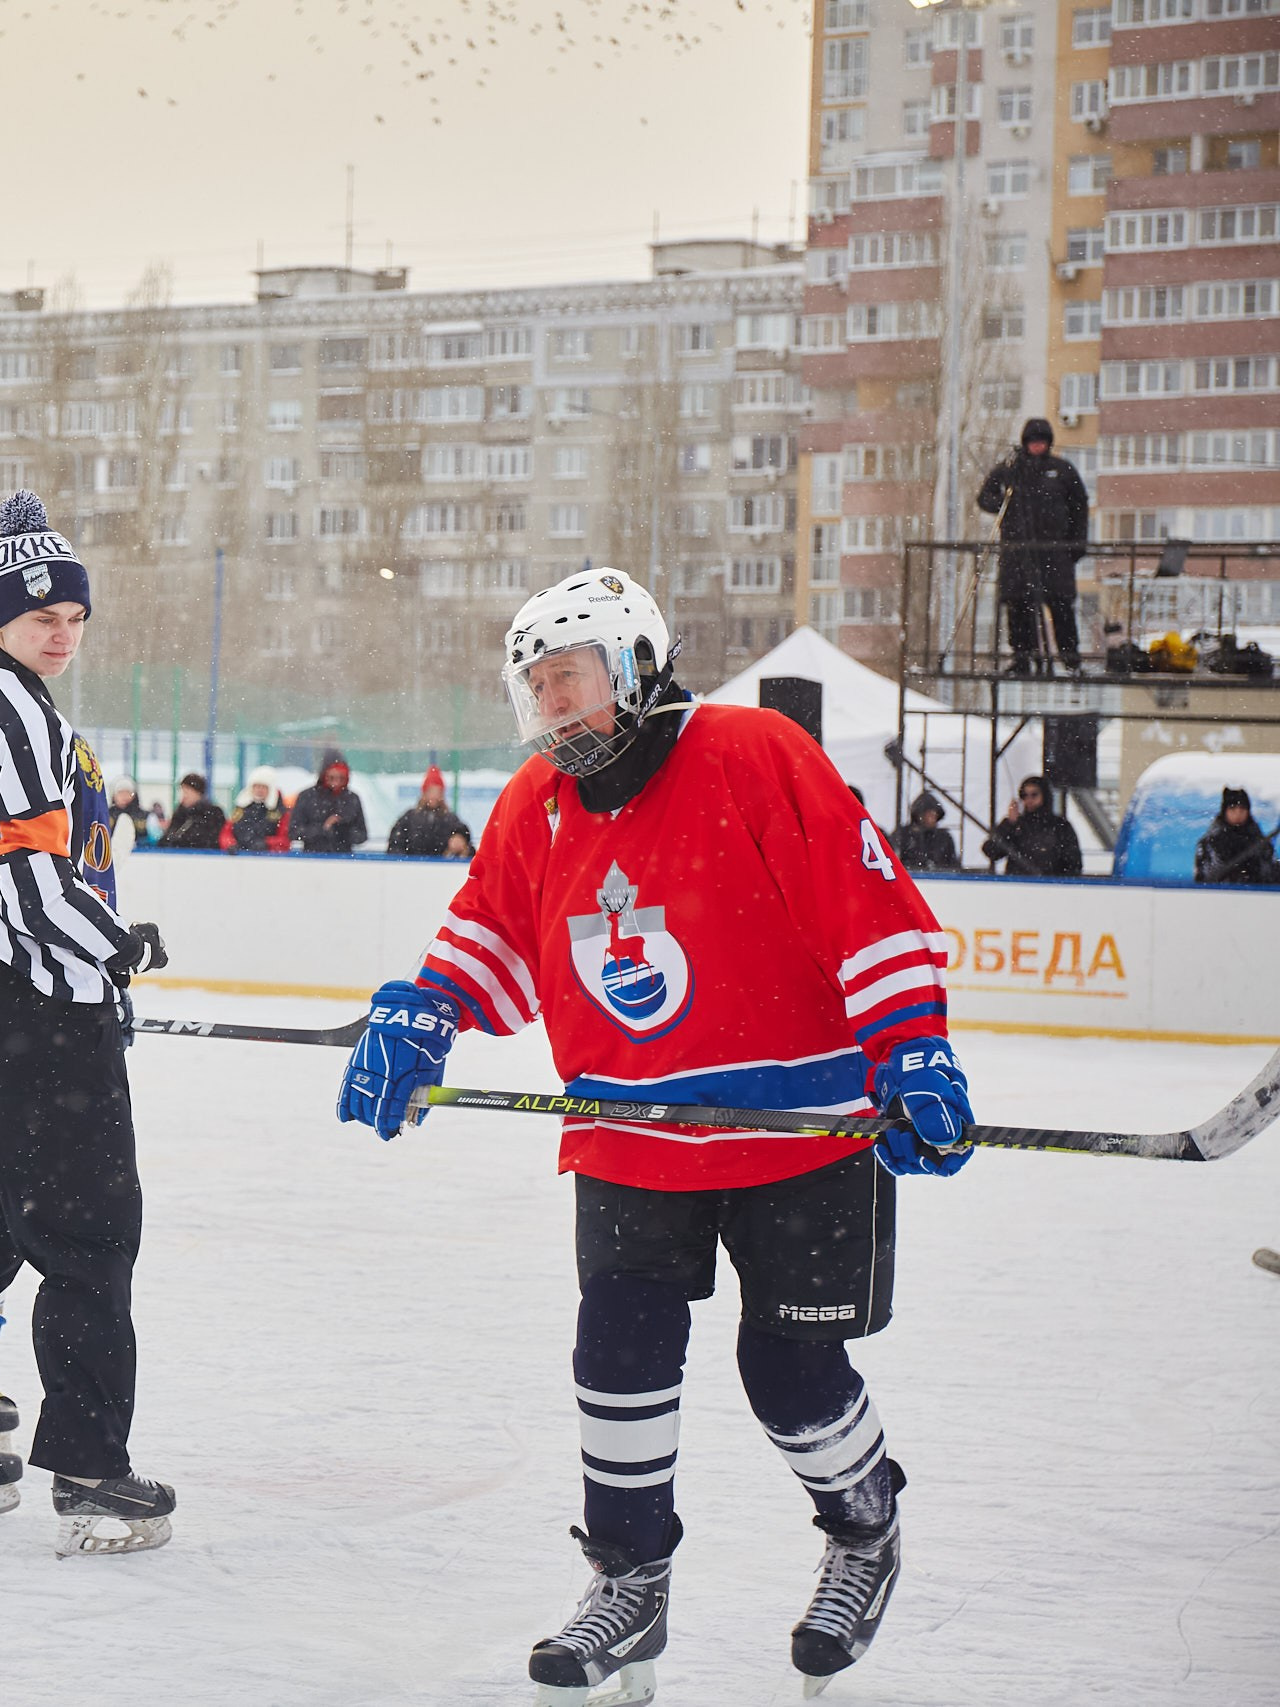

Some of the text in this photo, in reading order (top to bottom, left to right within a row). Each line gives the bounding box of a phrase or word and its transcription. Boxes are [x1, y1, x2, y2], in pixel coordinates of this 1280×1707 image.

[588, 594, 622, 604] Reebok
[456, 1096, 510, 1107] WARRIOR
[513, 1095, 601, 1115] ALPHA
